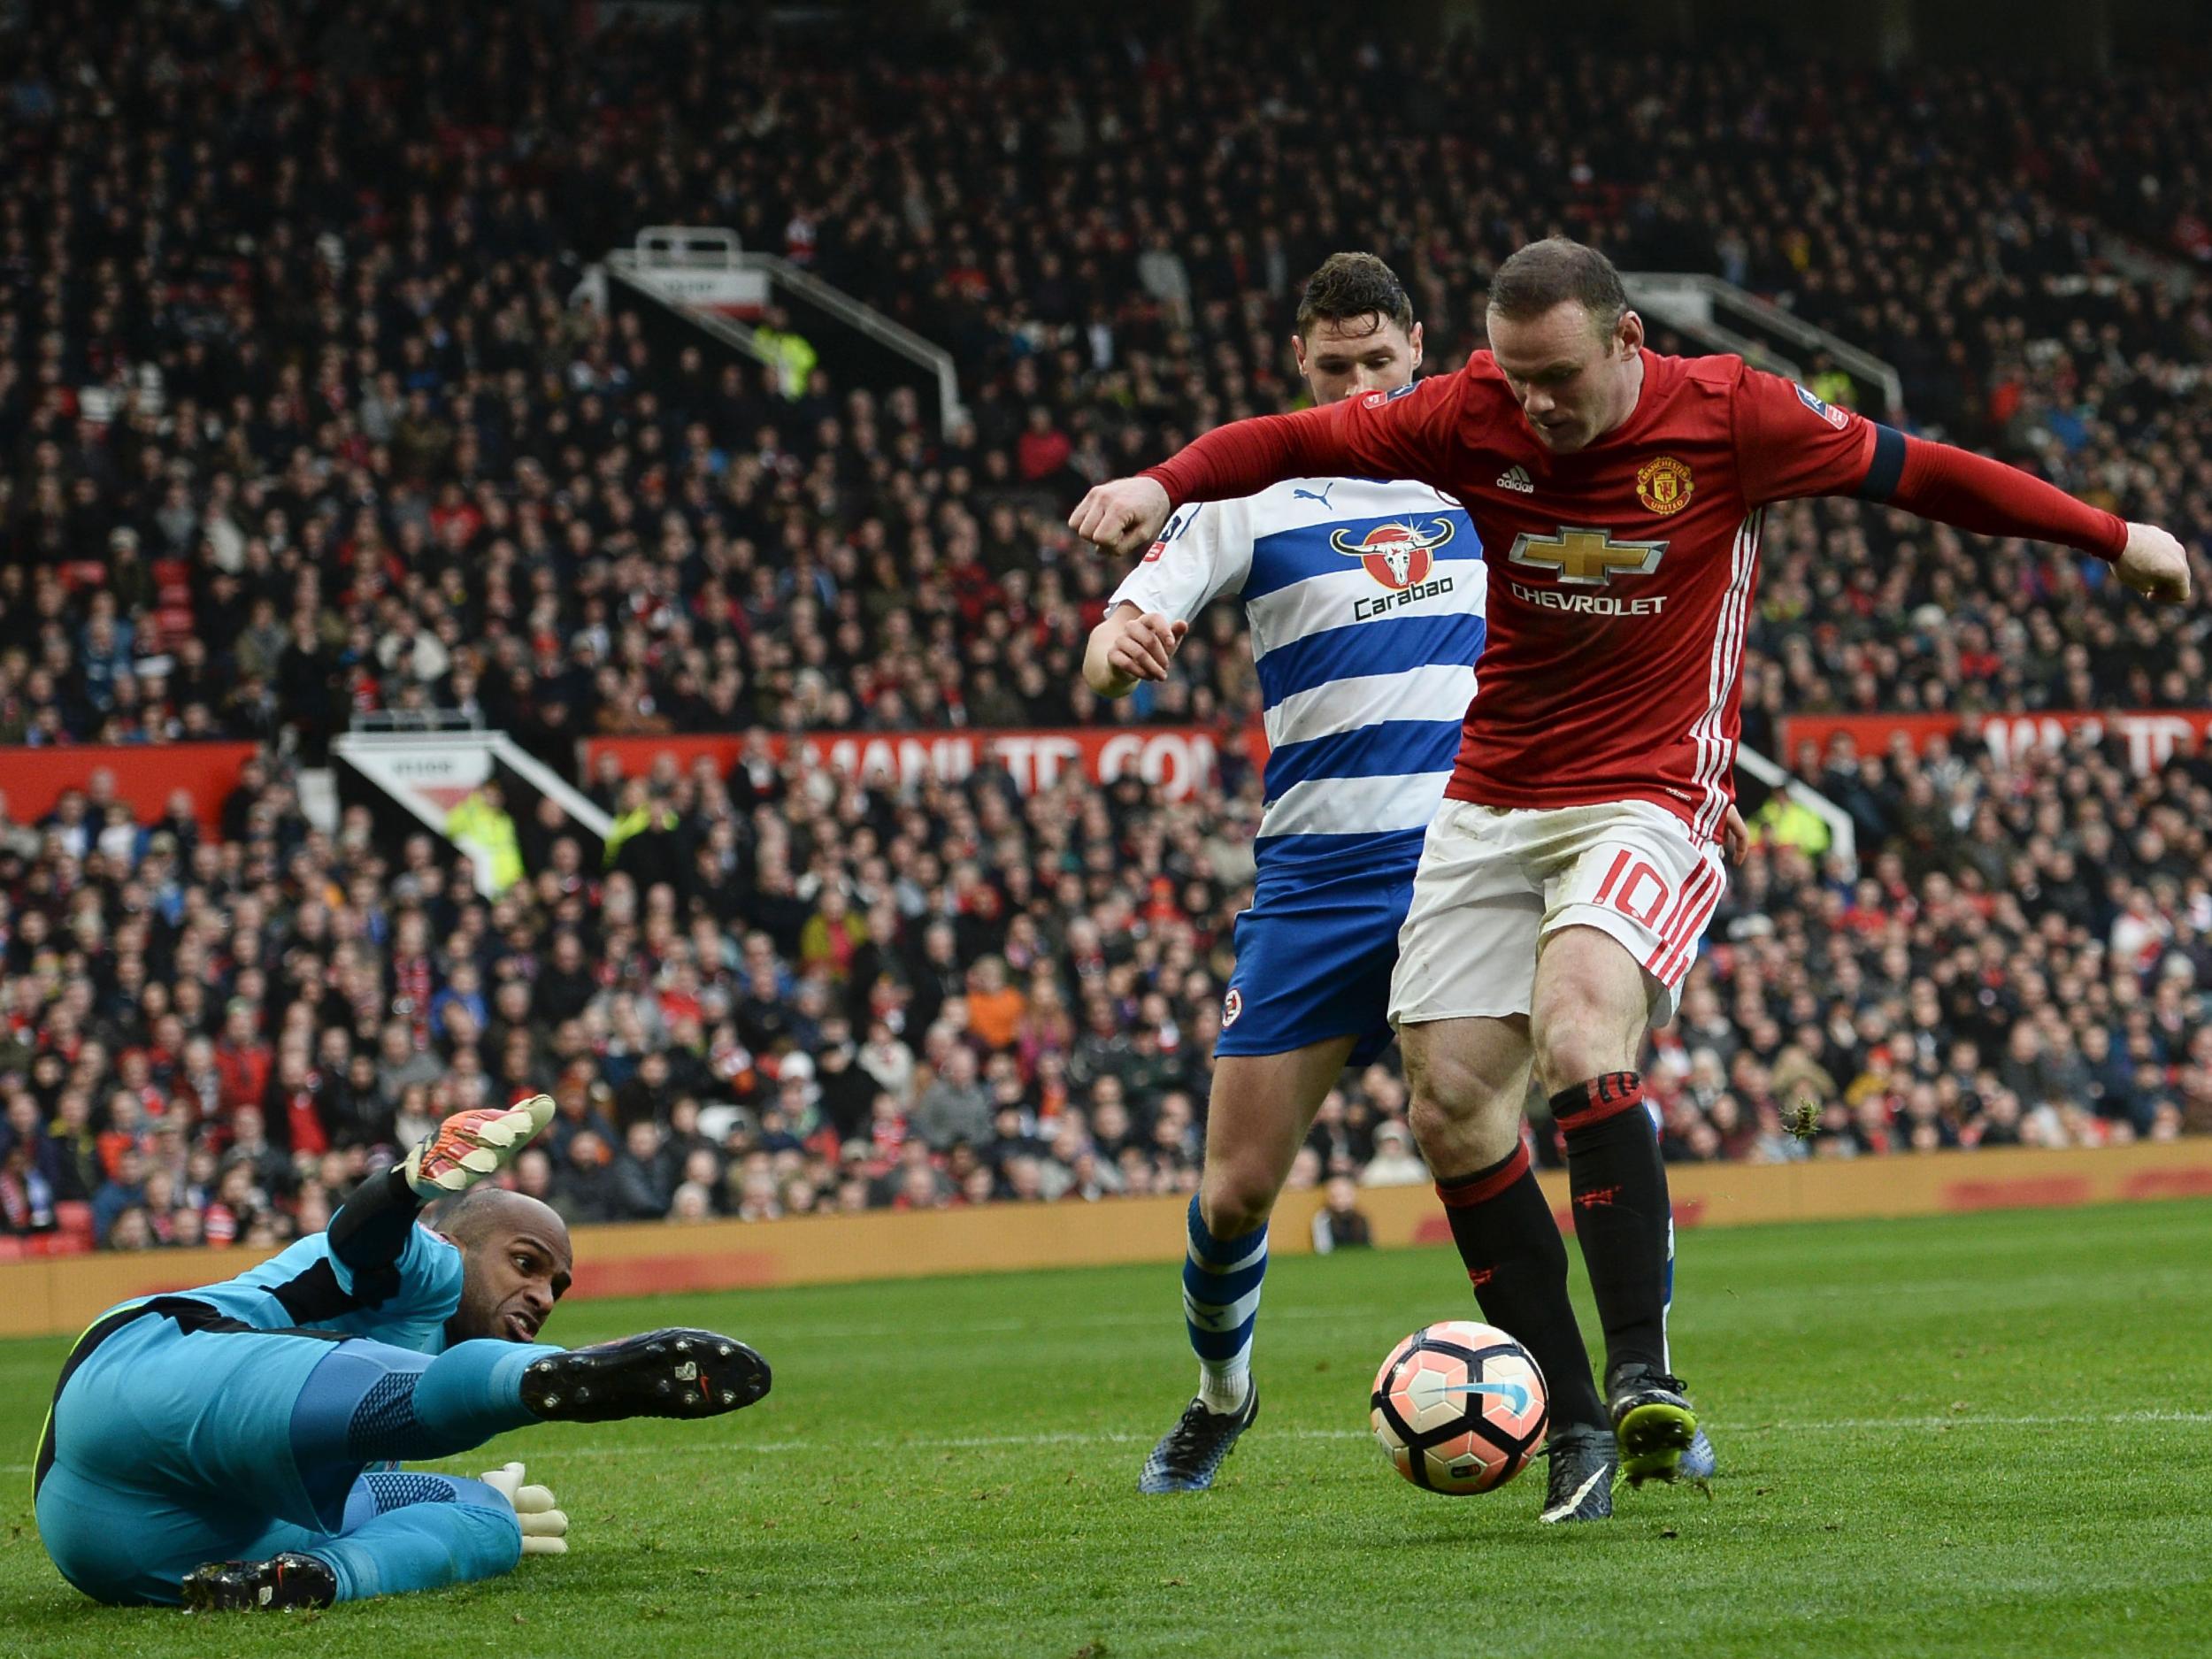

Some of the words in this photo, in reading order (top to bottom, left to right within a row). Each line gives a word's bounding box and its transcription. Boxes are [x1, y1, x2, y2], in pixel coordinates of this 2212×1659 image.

[1496, 477, 1534, 494] adidas
[1651, 499, 1683, 511] UNITED
[1354, 577, 1454, 621] Carabao
[1511, 583, 1668, 616] CHEVROLET
[1592, 849, 1669, 929] 10
